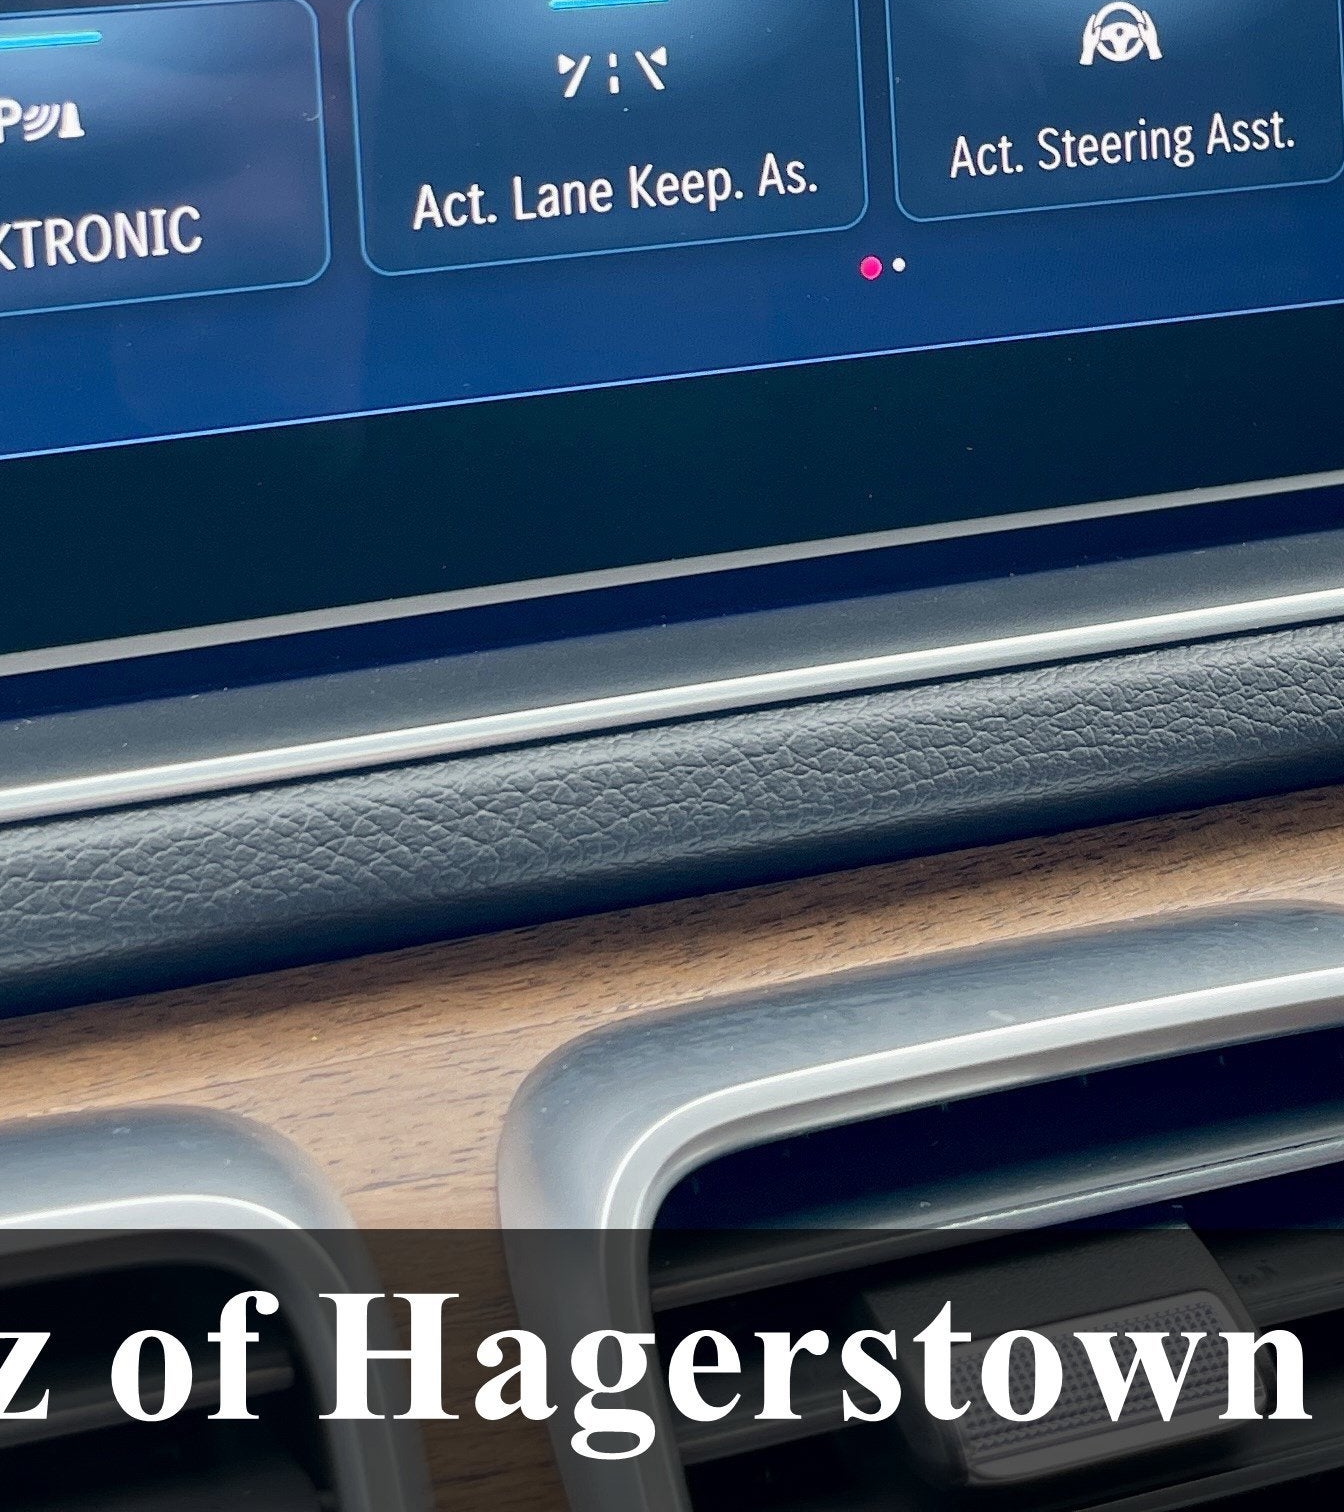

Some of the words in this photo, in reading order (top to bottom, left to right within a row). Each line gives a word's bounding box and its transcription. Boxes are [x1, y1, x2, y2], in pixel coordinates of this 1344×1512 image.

[950, 135, 1024, 179] Act.
[1037, 117, 1195, 171] Steering
[1206, 111, 1295, 155] Asst.
[412, 183, 498, 230] Act.
[513, 175, 614, 221] Lane
[628, 163, 744, 212] Keep.
[758, 152, 818, 197] As.
